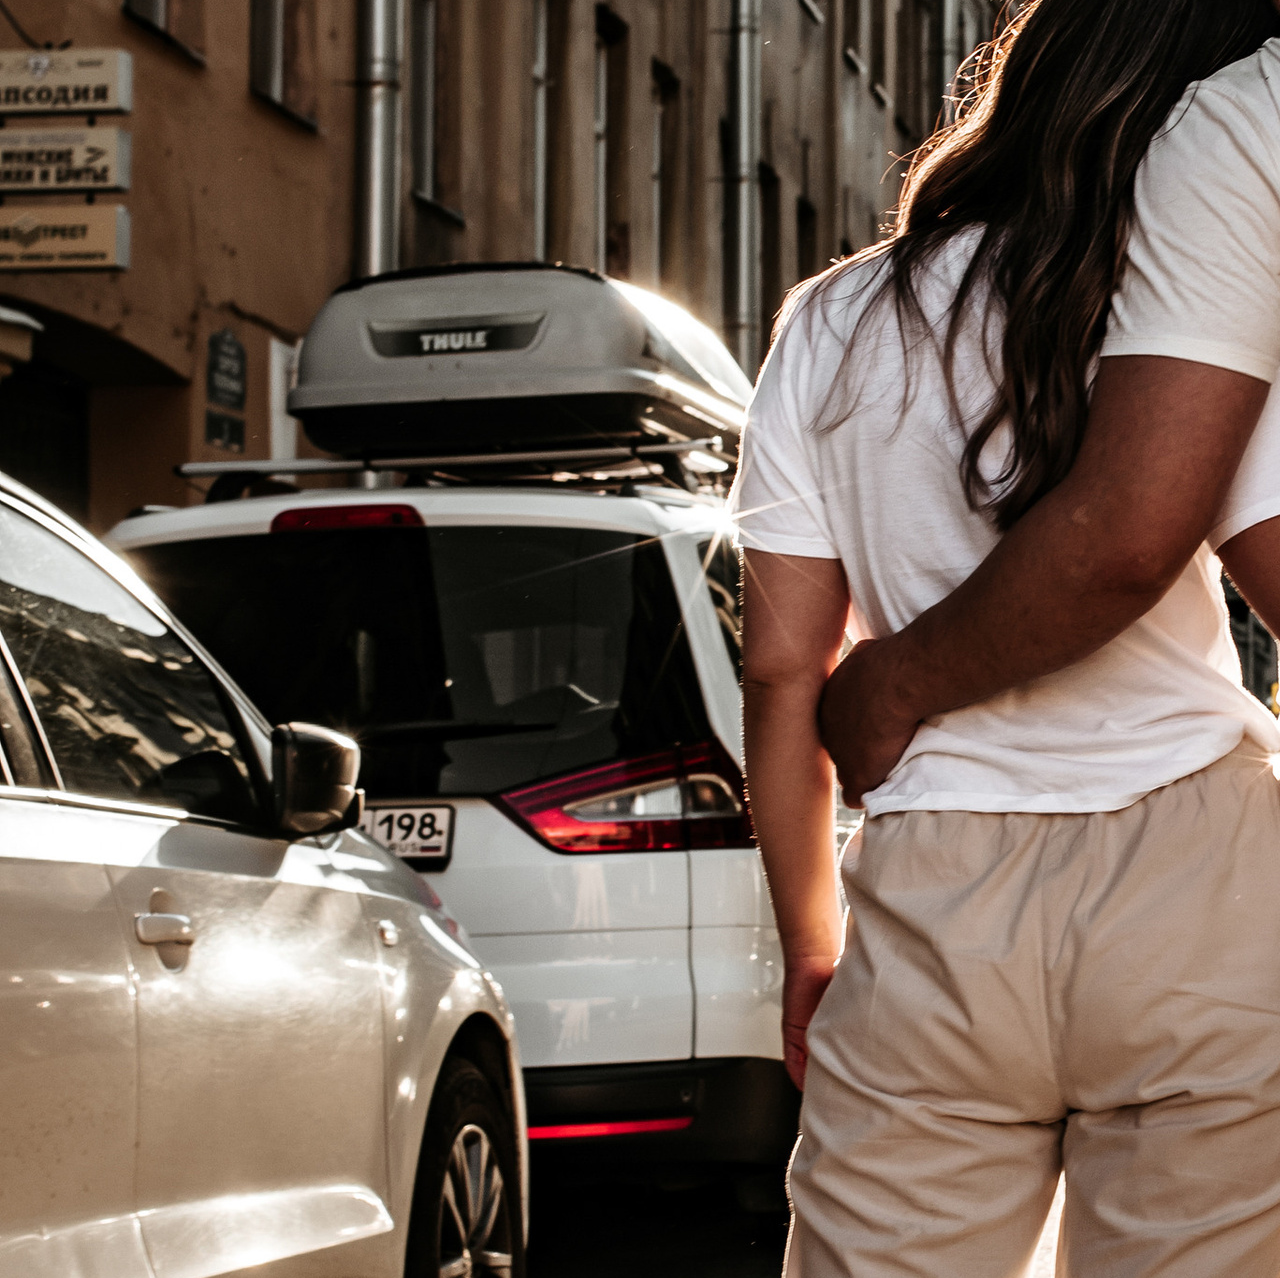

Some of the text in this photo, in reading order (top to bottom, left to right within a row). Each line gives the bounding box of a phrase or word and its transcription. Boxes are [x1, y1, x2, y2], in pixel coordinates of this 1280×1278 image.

[0, 85, 108, 107] псодия
[420, 331, 487, 351] THULE
[378, 812, 436, 840] 198
